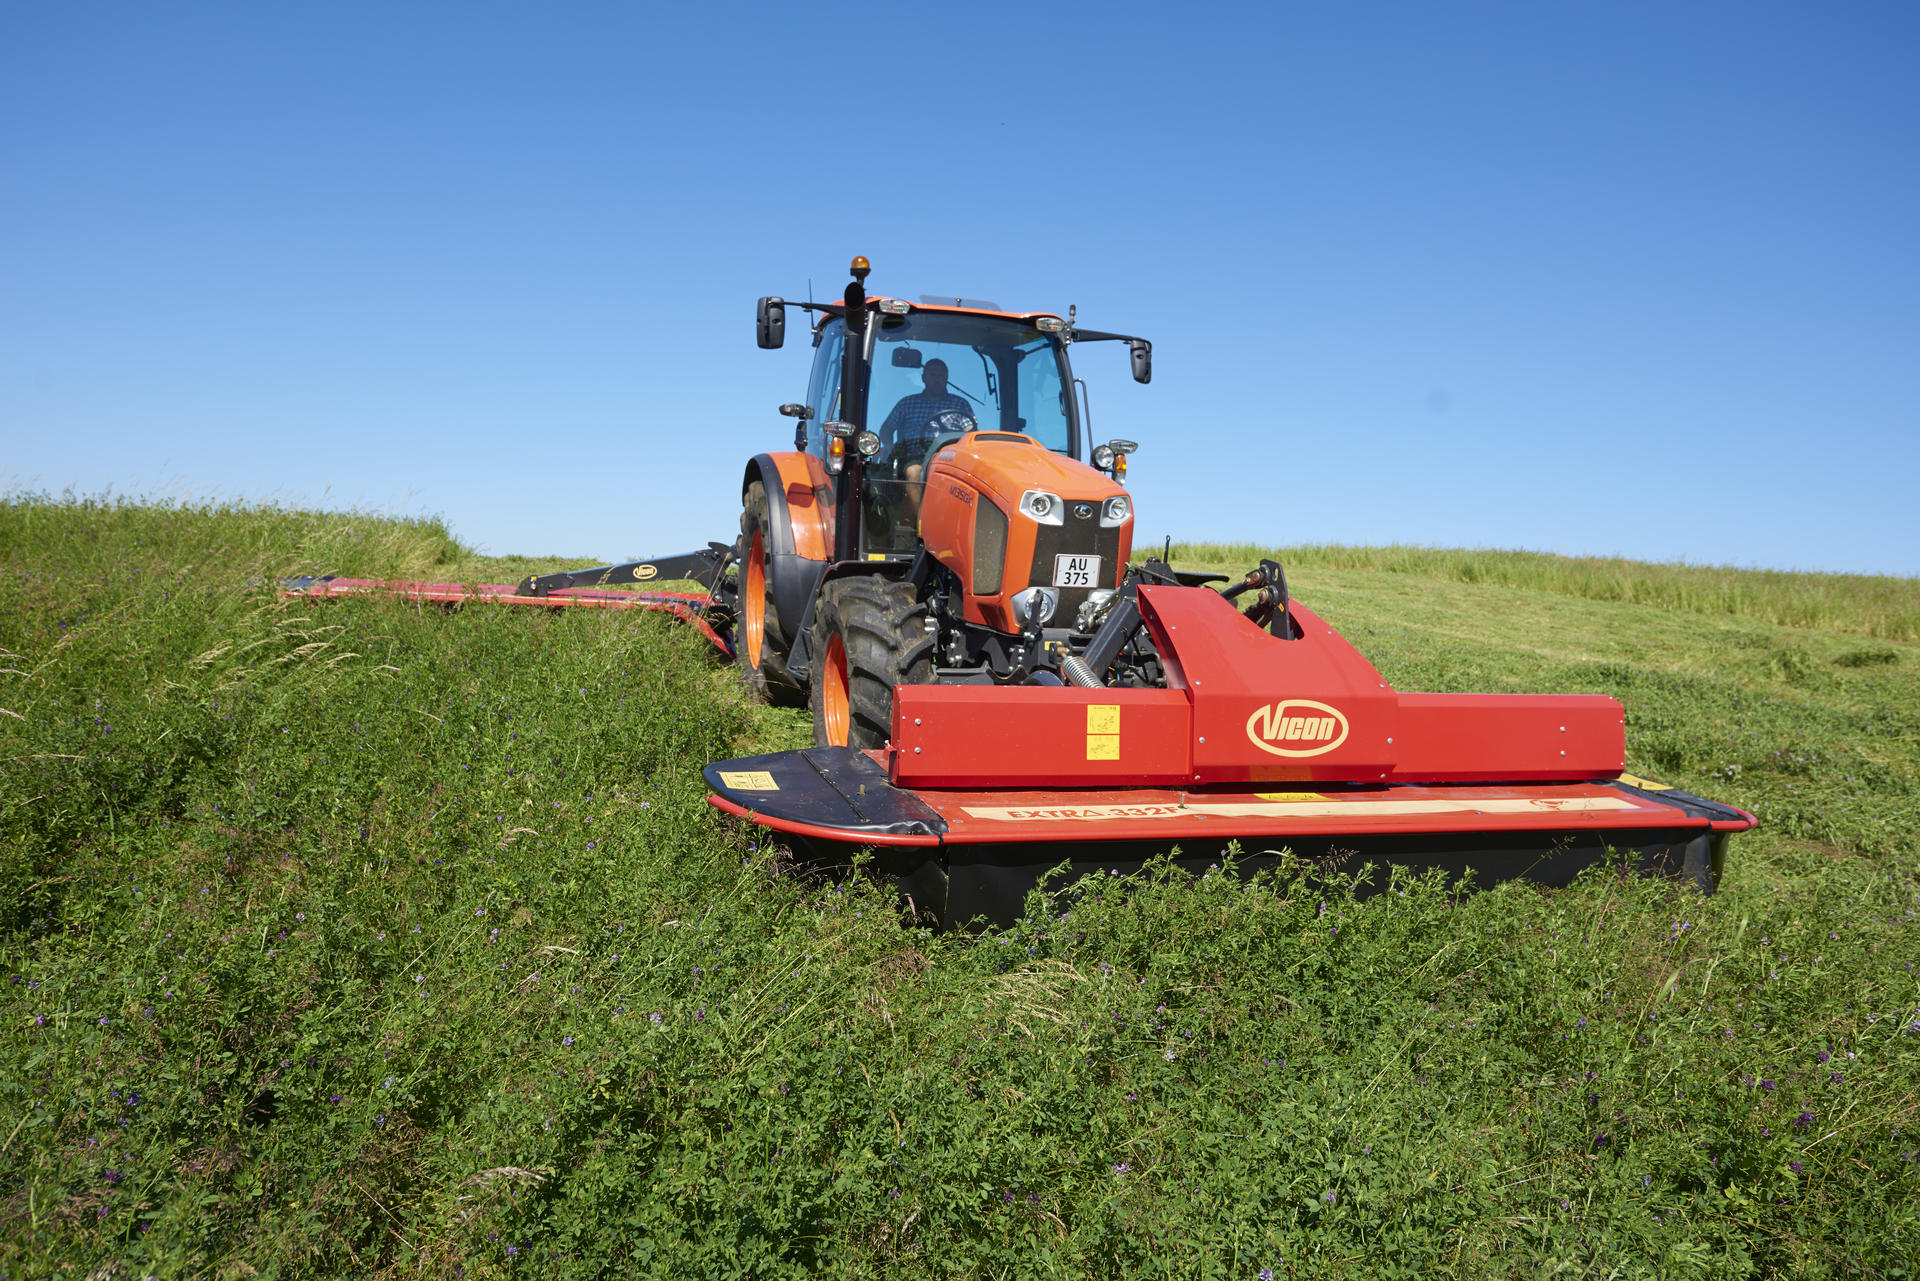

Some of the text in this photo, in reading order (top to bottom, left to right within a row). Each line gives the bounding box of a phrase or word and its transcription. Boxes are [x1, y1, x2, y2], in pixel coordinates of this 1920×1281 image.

[1068, 558, 1087, 571] AU
[1063, 572, 1088, 585] 375
[1007, 806, 1179, 819] EXTRA 332F
